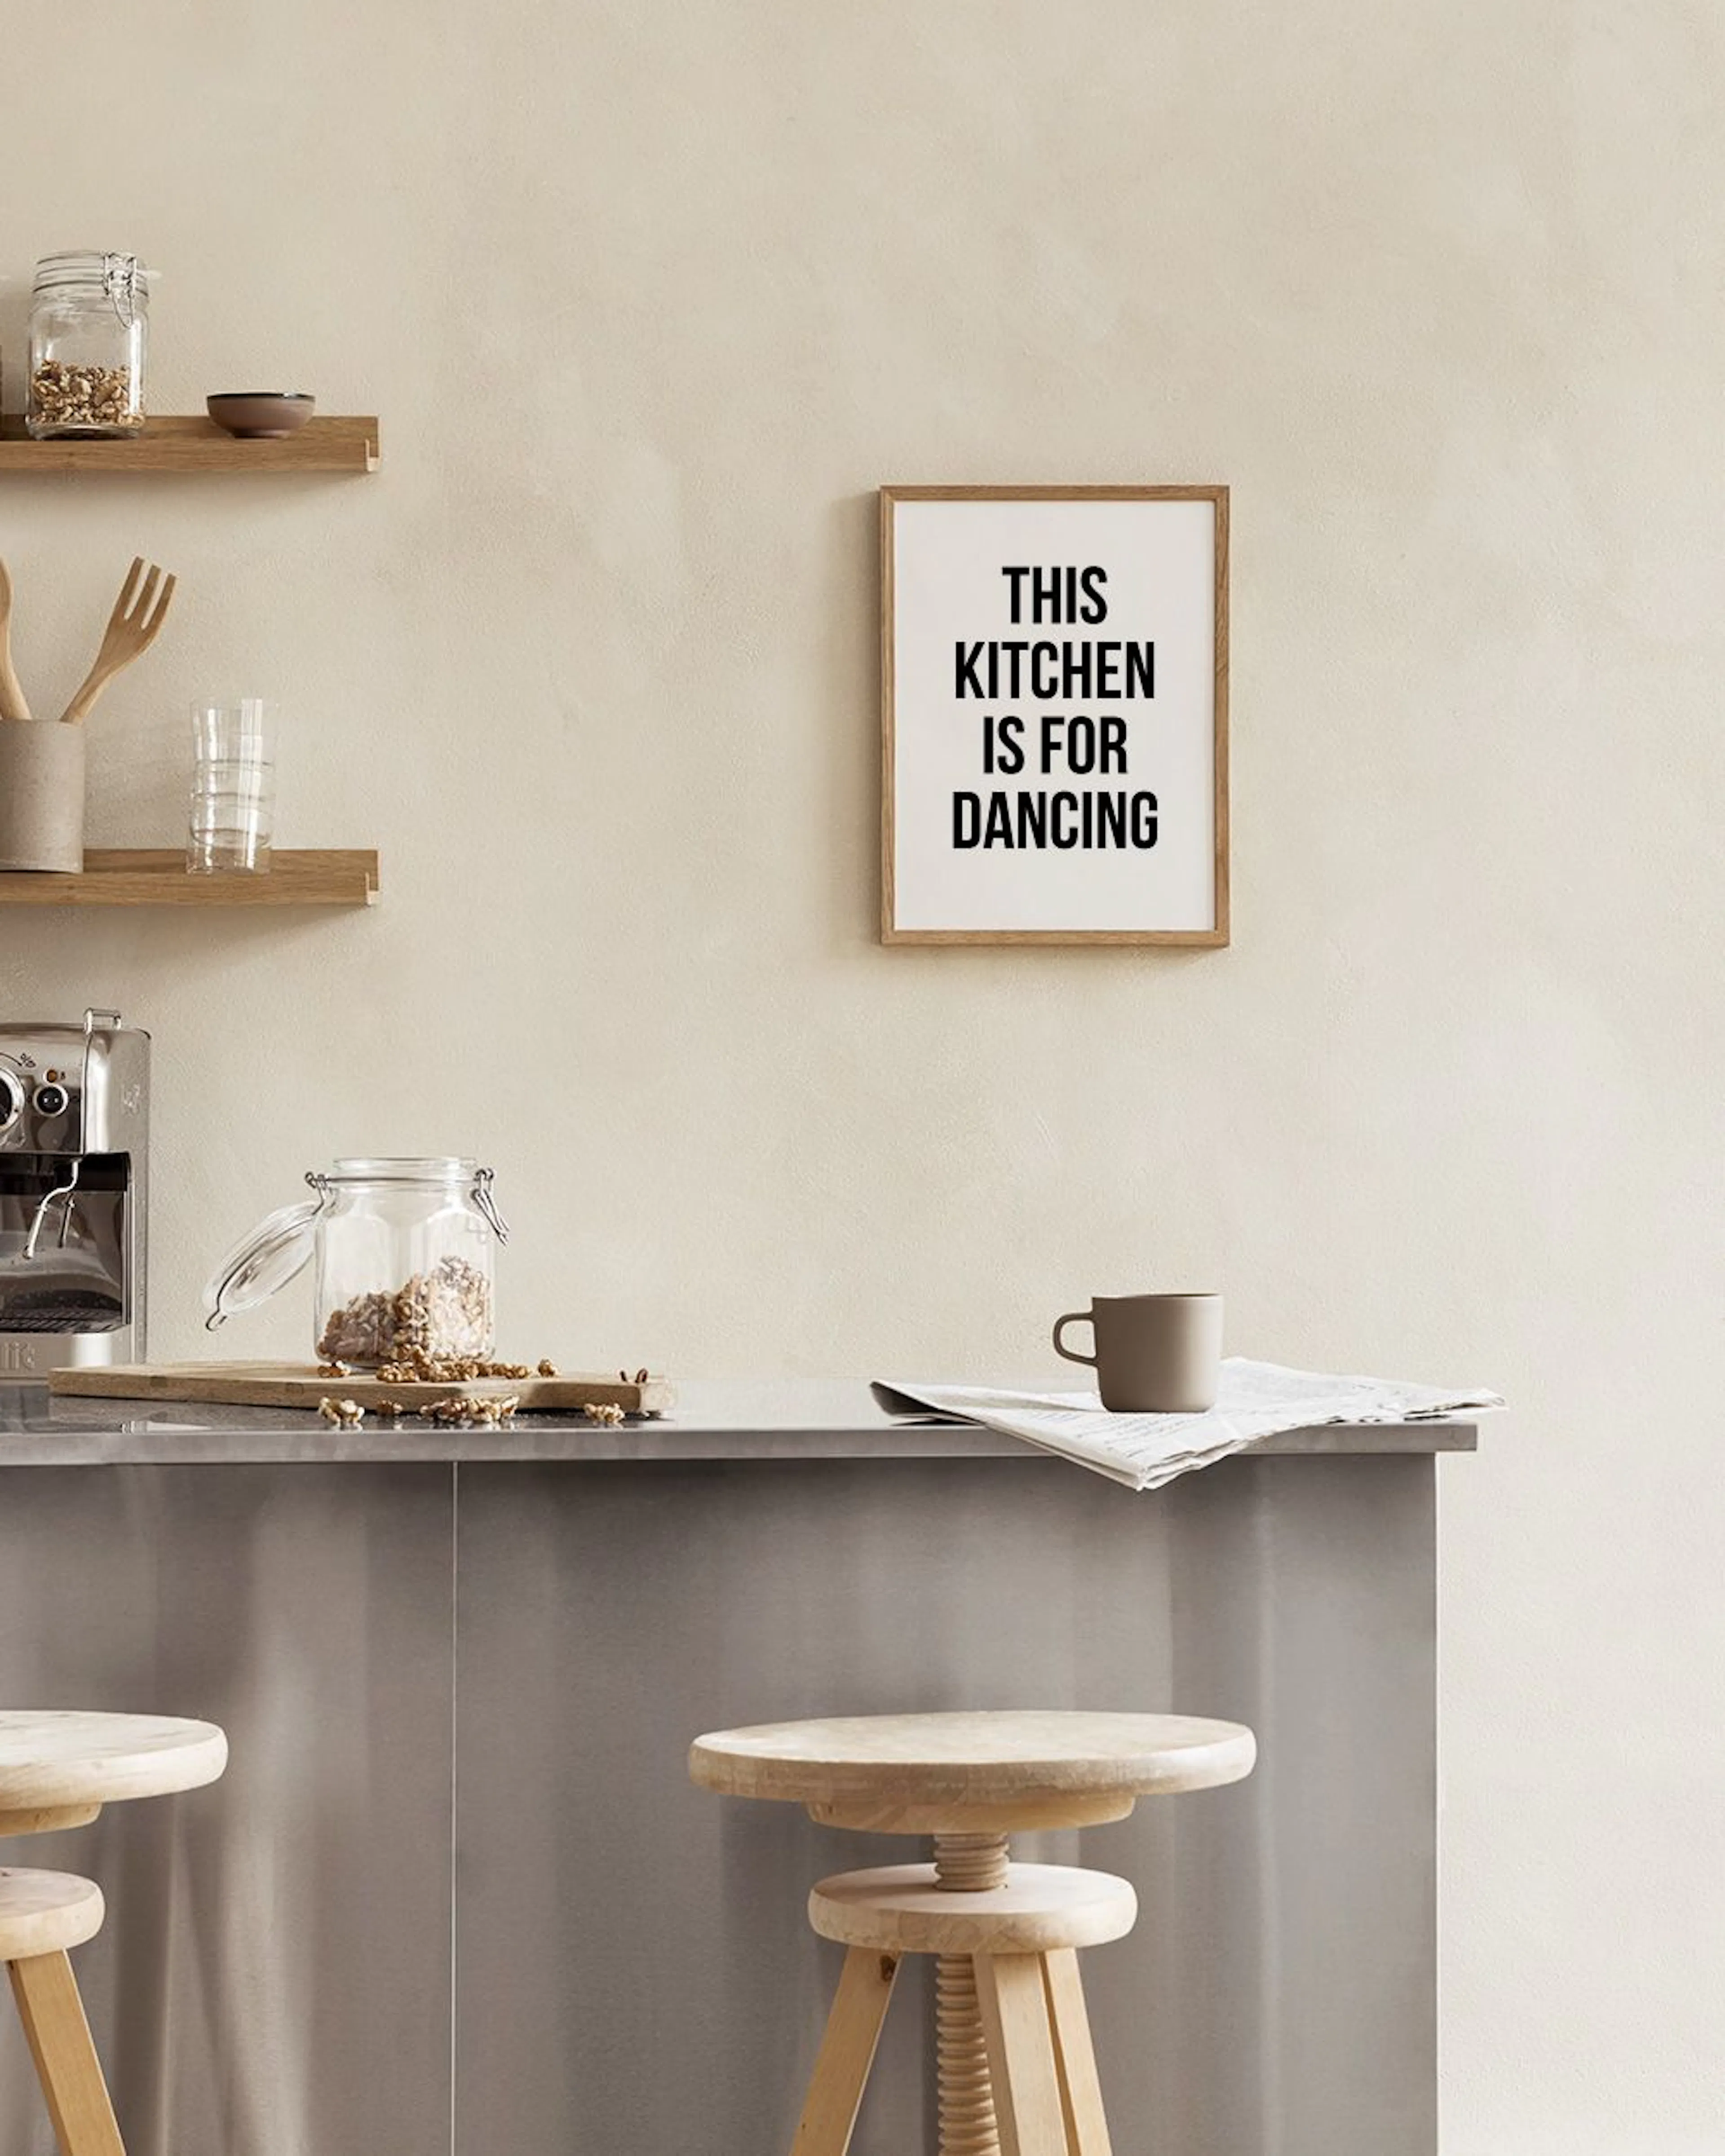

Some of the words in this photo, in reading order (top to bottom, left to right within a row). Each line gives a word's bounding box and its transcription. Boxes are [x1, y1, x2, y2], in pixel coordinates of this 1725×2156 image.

[1002, 566, 1107, 624] THIS
[955, 641, 1154, 699] KITCHEN
[984, 716, 1025, 774] IS
[1041, 716, 1127, 774] FOR
[953, 791, 1158, 849] DANCING
